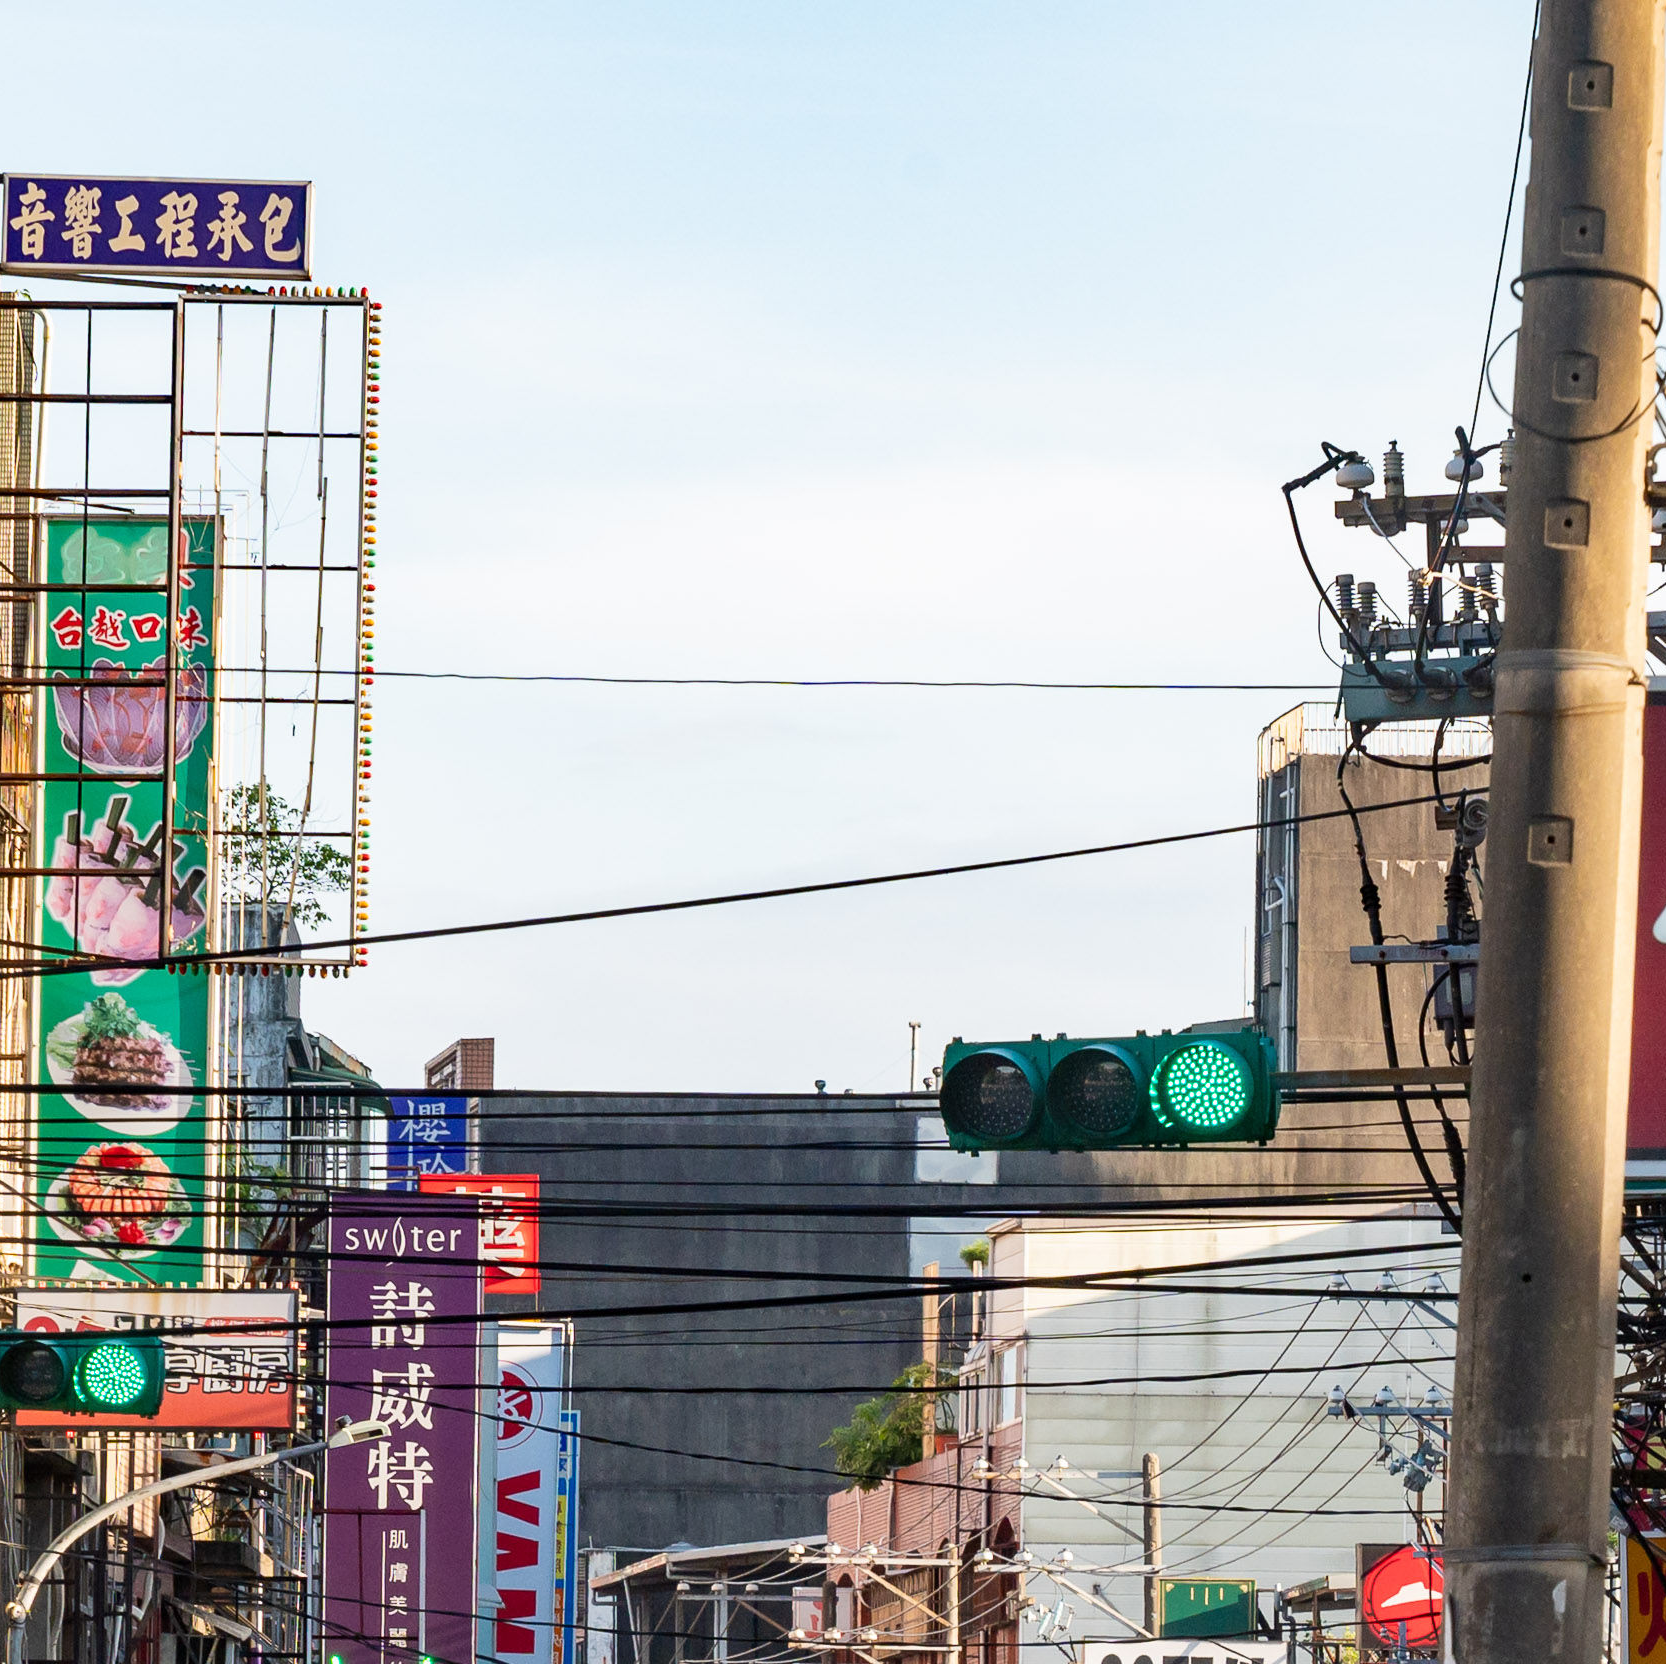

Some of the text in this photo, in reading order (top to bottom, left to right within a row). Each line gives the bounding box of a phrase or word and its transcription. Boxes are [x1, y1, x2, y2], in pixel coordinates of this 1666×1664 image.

[9, 181, 301, 261] 音響工程承包
[50, 605, 209, 652] 台越口味
[367, 1281, 436, 1511] 詩威特
